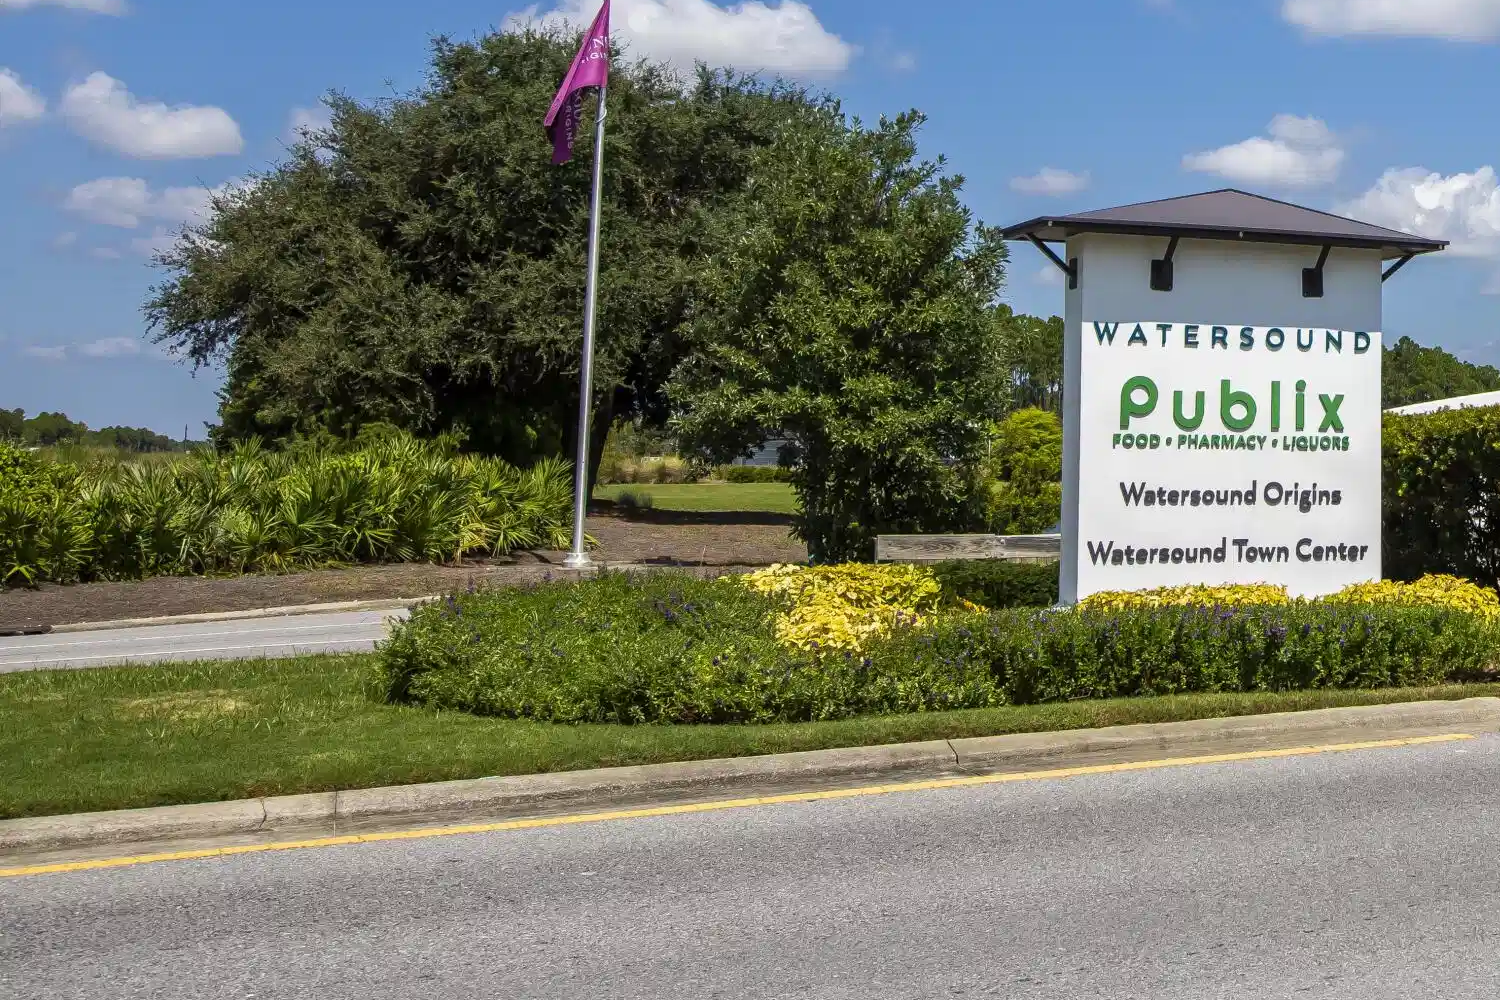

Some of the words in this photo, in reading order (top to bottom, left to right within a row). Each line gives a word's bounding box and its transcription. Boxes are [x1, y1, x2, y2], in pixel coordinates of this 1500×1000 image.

[1093, 321, 1371, 355] WATERSOUND
[1119, 375, 1345, 433] Publix
[1112, 433, 1161, 450] FOOD
[1177, 434, 1268, 451] PHARMACY
[1283, 435, 1350, 453] LIQUORS
[1119, 480, 1257, 507] Watersound
[1263, 482, 1342, 513] Origins
[1087, 537, 1227, 566] Watersound
[1232, 538, 1289, 563] Town
[1295, 538, 1368, 563] Center
